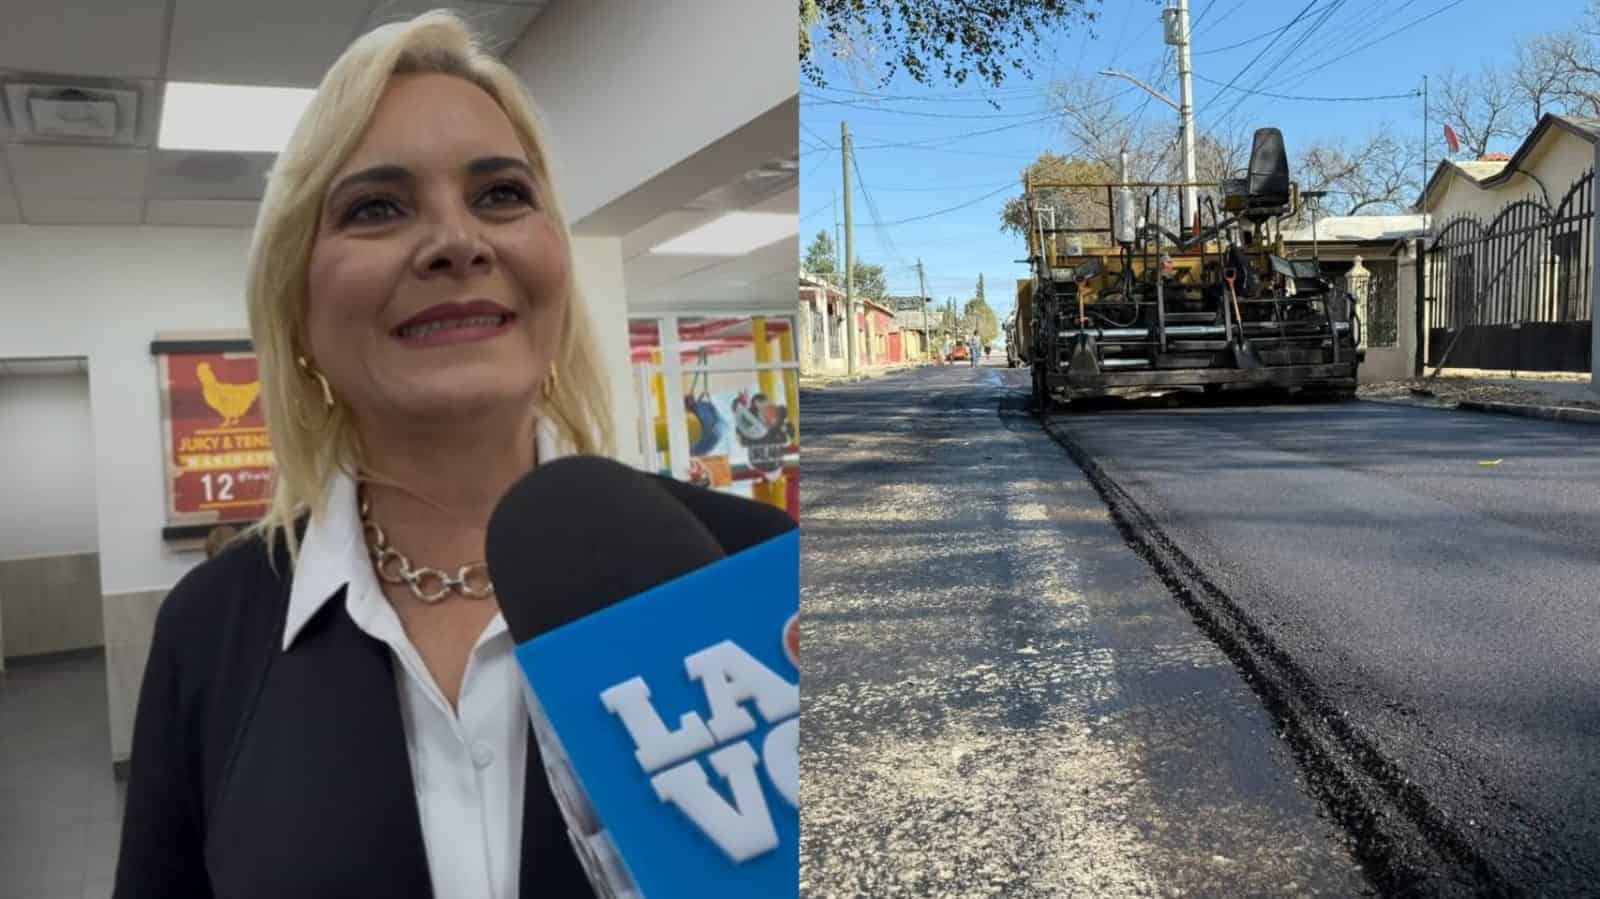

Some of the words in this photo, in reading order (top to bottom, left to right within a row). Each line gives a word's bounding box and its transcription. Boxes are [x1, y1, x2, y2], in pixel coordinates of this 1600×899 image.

[179, 437, 220, 452] JUICY
[201, 473, 235, 502] 12
[600, 640, 799, 773] LA
